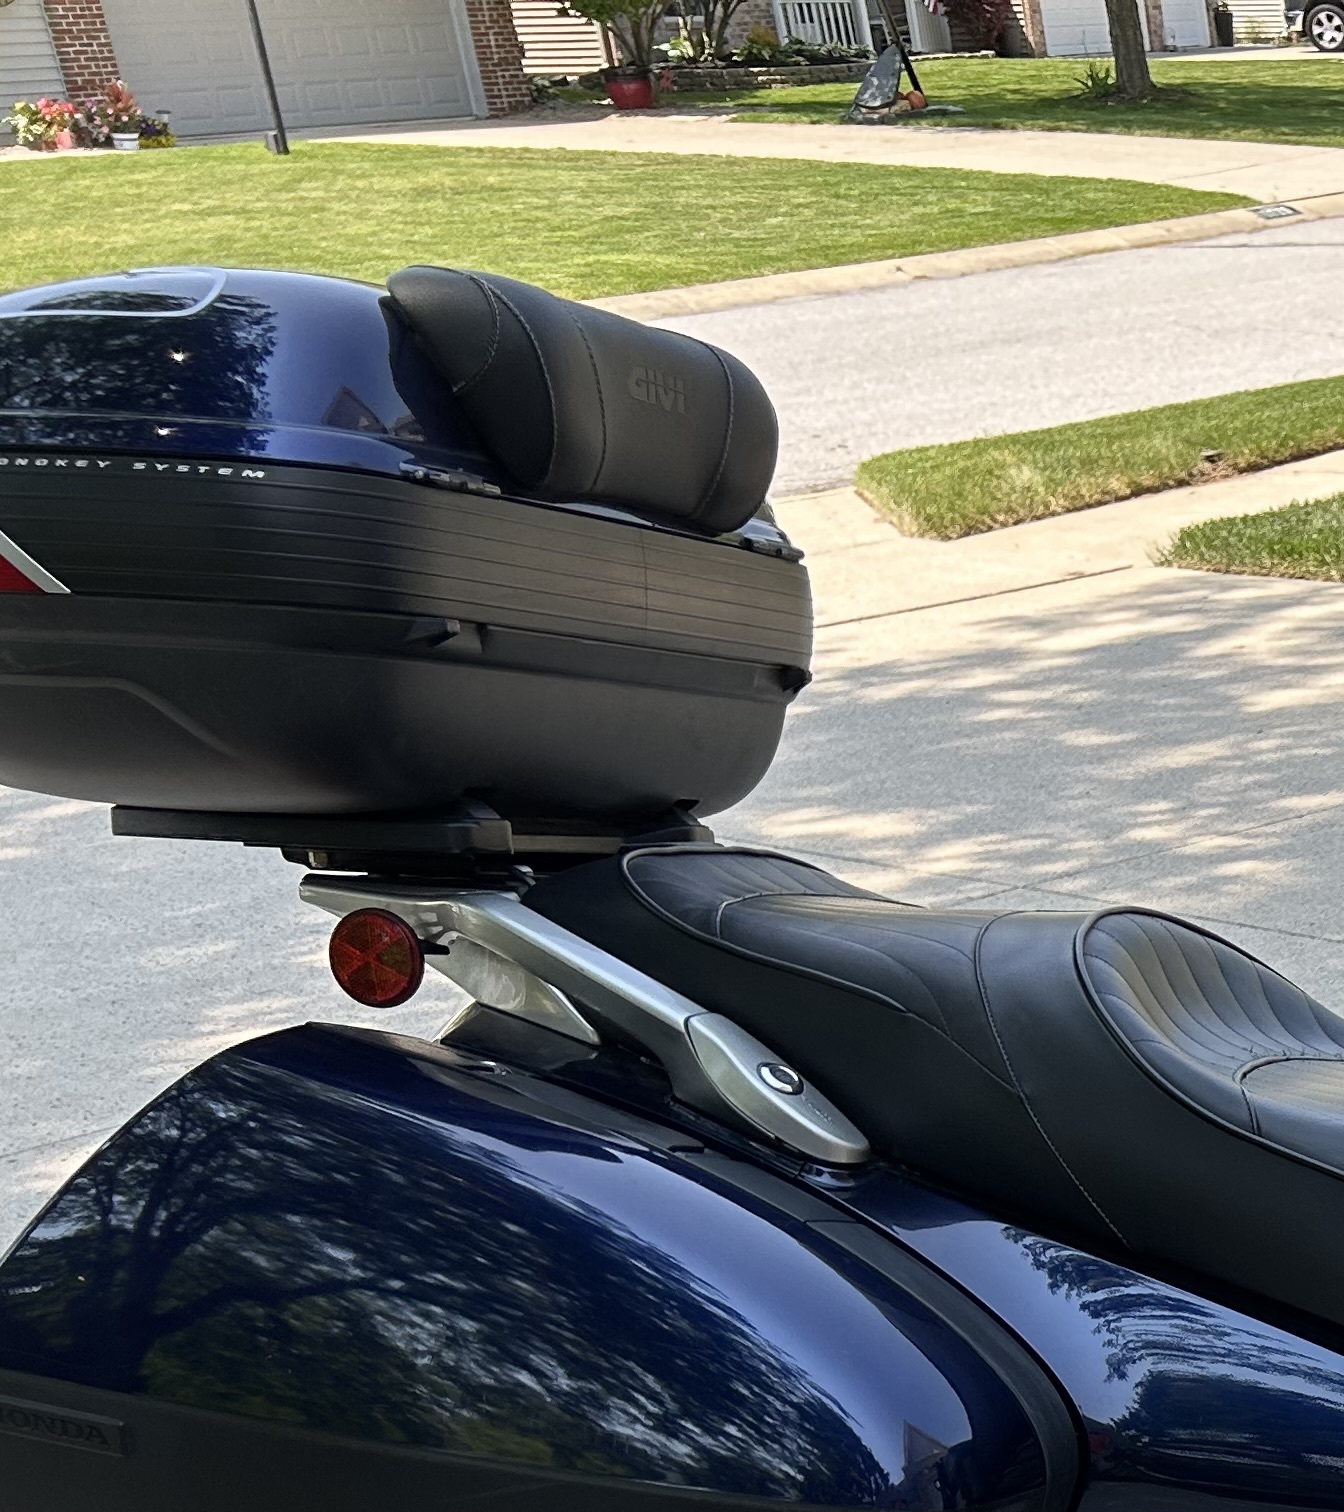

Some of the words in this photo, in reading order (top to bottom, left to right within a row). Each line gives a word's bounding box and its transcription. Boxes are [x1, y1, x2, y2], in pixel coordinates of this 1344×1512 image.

[627, 363, 687, 416] GIVI
[132, 462, 266, 478] SYSTEM
[0, 1407, 110, 1445] ONDA
